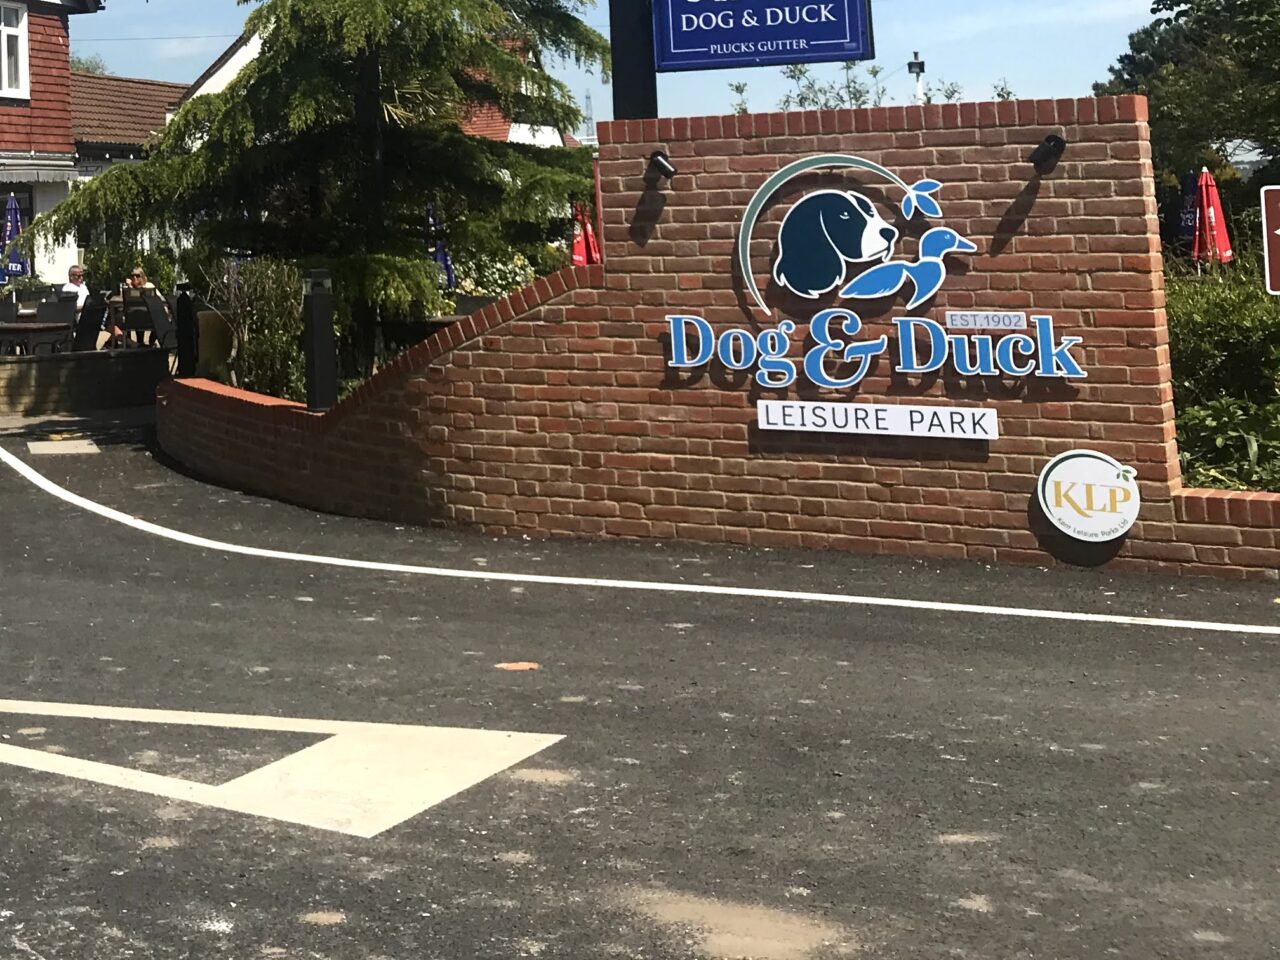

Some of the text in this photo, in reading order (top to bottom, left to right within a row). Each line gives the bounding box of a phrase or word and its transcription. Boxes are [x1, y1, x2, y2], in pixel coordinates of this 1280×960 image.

[681, 3, 837, 31] DOG & DUCK
[710, 39, 809, 54] PLUCKS GUTTER
[949, 314, 1022, 328] EST.1902
[665, 308, 1089, 388] Dog & Duck
[765, 405, 989, 435] LEISURE PARK
[1052, 480, 1131, 518] KLP
[1057, 517, 1072, 530] Kent
[1073, 526, 1099, 538] Leisure
[1101, 526, 1120, 537] Parks
